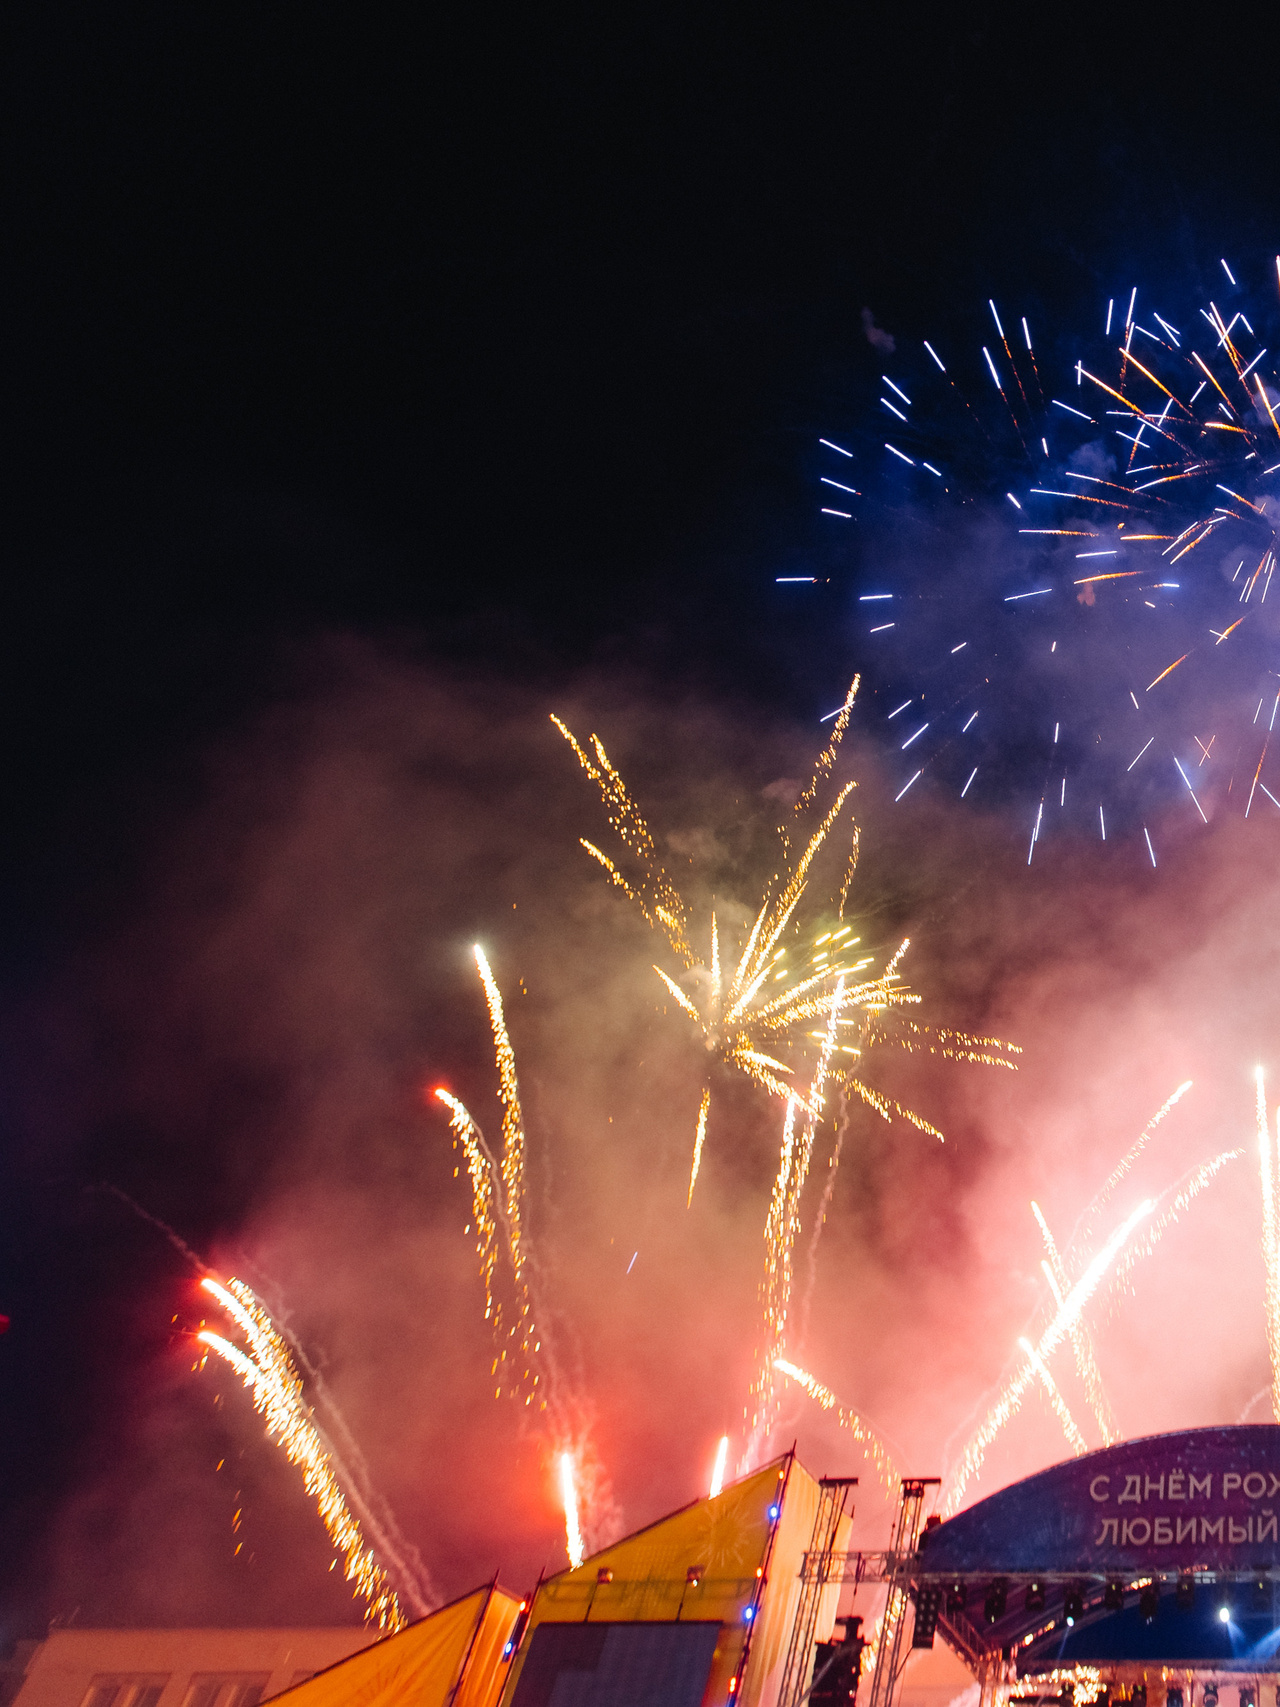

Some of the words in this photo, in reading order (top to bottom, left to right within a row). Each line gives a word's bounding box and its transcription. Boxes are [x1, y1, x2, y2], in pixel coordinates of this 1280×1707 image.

[1089, 1475, 1111, 1502] С
[1117, 1469, 1213, 1505] ДНЁМ
[1095, 1509, 1279, 1546] ЛЮБИМЫЙ
